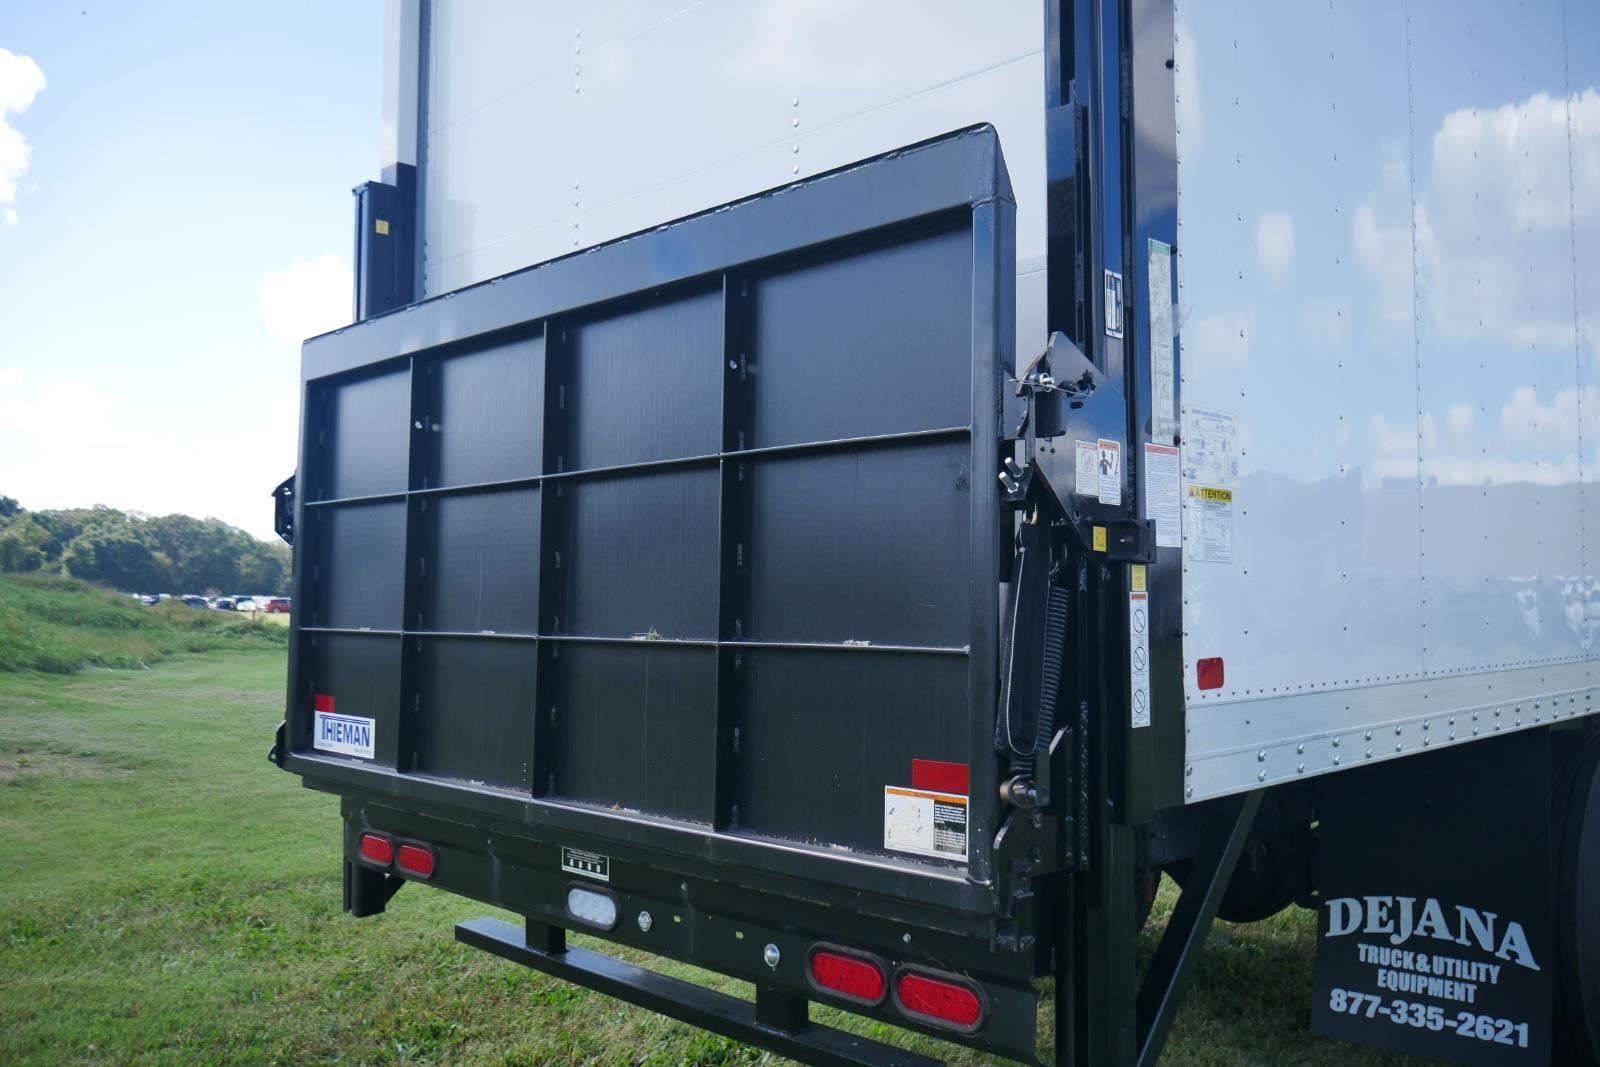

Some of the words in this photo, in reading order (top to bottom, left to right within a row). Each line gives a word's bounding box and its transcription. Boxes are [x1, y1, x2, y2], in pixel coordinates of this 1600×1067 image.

[1195, 488, 1232, 501] ATTENTION
[320, 715, 370, 748] THIEMAN
[1325, 896, 1541, 971] DEJANA
[1357, 943, 1415, 971] TRUCK
[1433, 955, 1501, 985] UTILITY
[1377, 969, 1478, 1004] EQUIPMENT
[1329, 987, 1529, 1049] 877-335-2621
